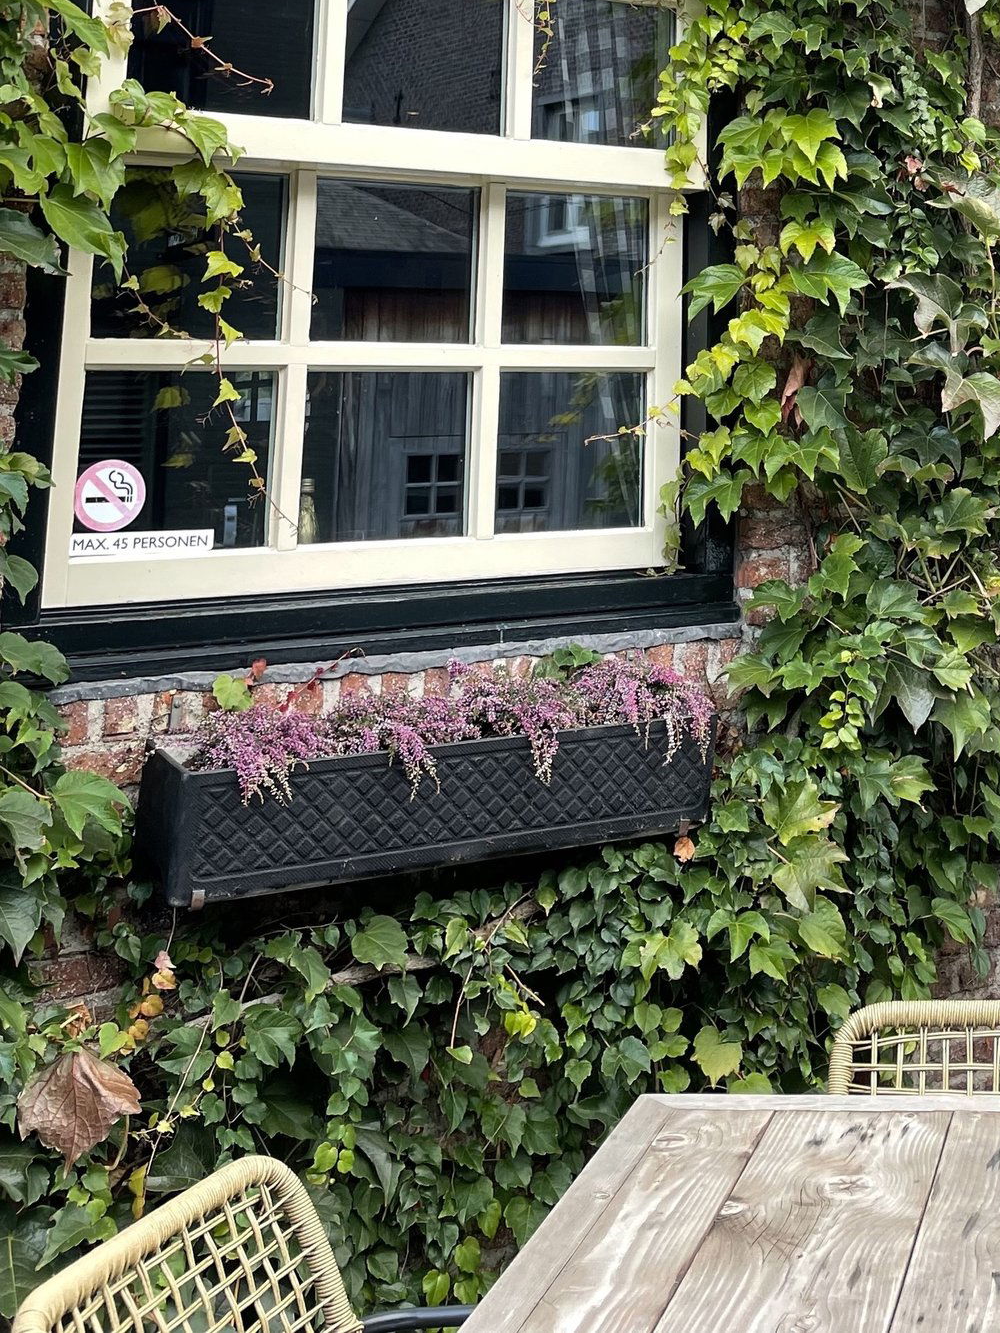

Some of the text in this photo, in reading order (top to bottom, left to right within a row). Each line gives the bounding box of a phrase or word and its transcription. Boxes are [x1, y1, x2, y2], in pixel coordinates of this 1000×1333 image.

[72, 535, 208, 551] MAX. 45 PERSONEN
